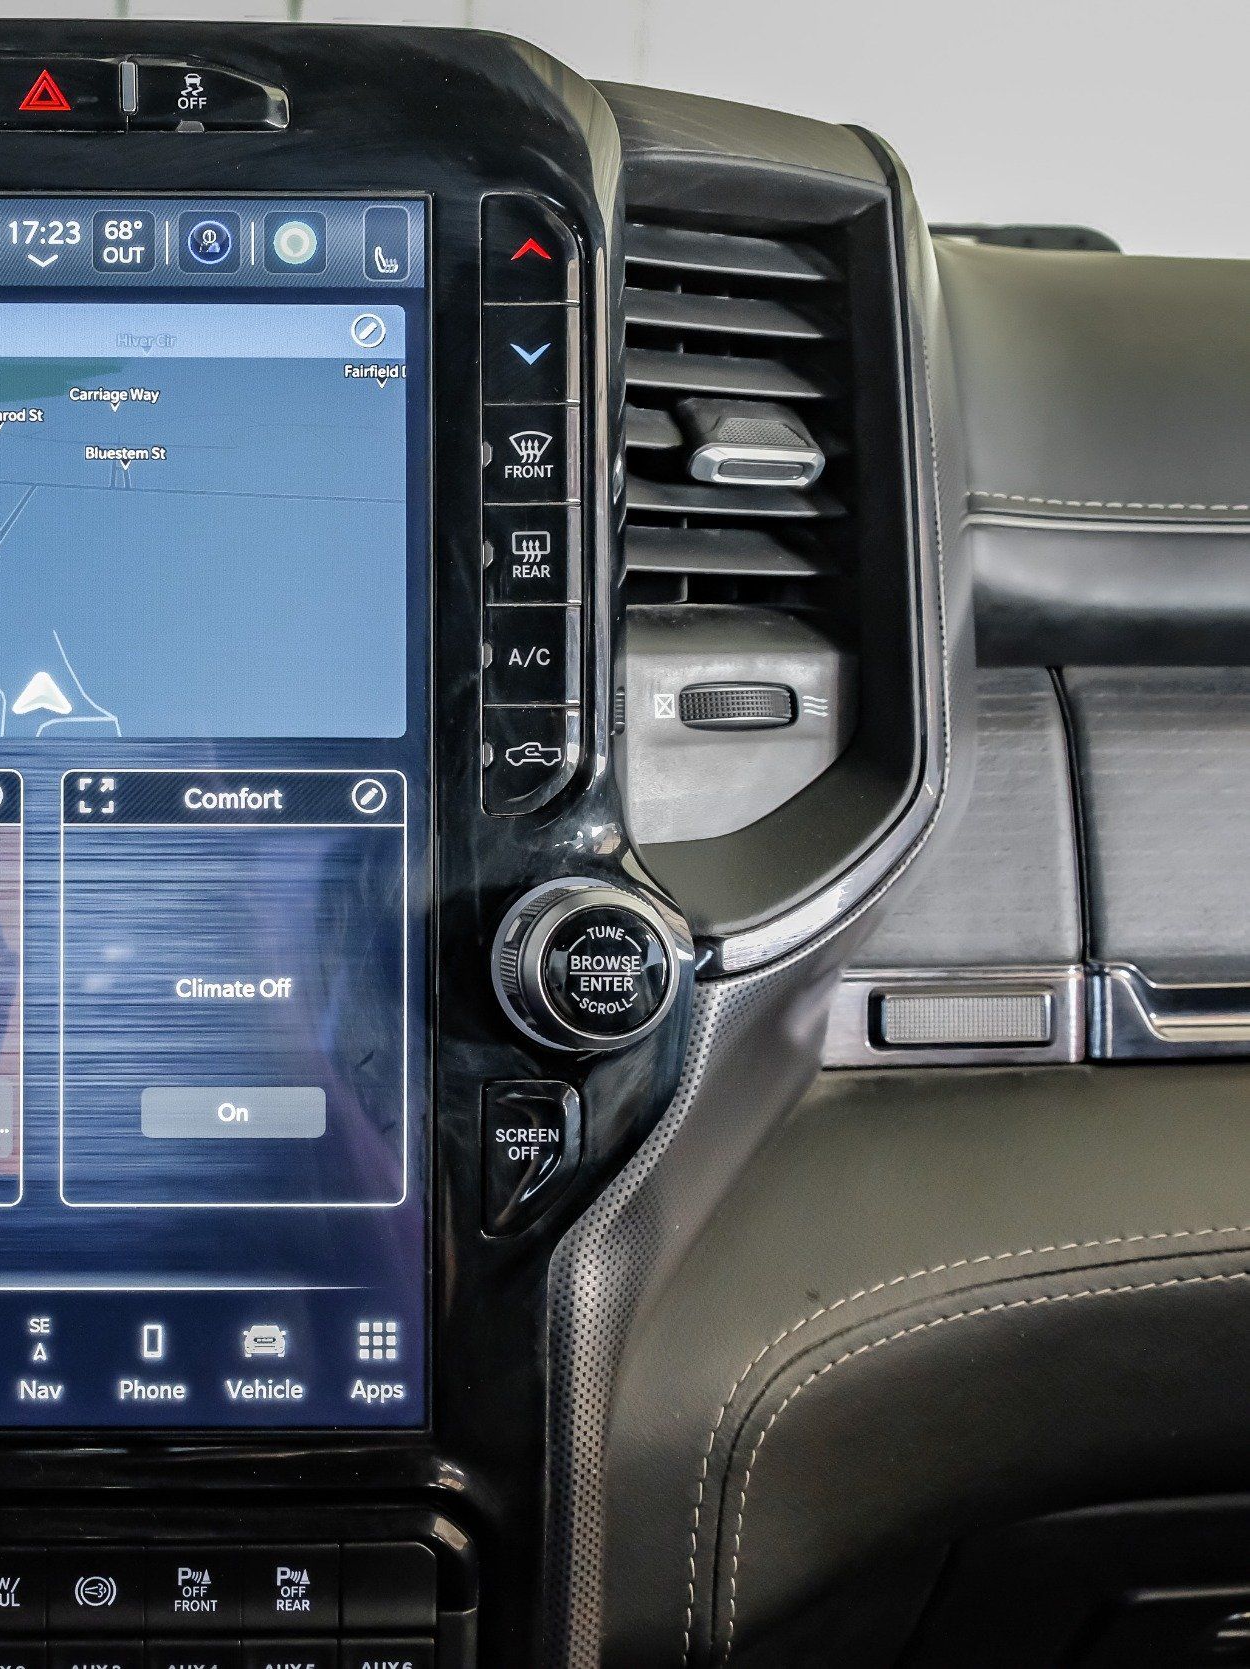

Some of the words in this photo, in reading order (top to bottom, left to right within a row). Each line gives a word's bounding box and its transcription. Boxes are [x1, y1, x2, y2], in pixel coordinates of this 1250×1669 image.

[177, 97, 207, 110] OFF
[8, 220, 81, 245] 17:23
[104, 219, 143, 240] 68°
[102, 244, 146, 264] OUT
[344, 364, 399, 379] Fairfield
[69, 387, 128, 404] Carriage
[130, 388, 160, 404] Way
[28, 409, 44, 422] St
[85, 447, 149, 460] Bluestem
[151, 447, 167, 460] St
[504, 464, 554, 479] FRONT
[512, 564, 551, 578] REAR
[508, 646, 551, 668] A/C
[184, 788, 283, 811] Comfort
[587, 926, 625, 941] TUNE
[570, 955, 642, 972] BROWSE
[175, 975, 256, 998] Climate
[258, 977, 292, 999] Off
[579, 975, 635, 993] ENTER
[578, 996, 633, 1015] SCROLL
[217, 1102, 249, 1122] On
[495, 1128, 559, 1143] SCREEN
[507, 1147, 540, 1161] OFF
[29, 1317, 50, 1334] SE
[18, 1379, 63, 1400] Nav
[118, 1379, 187, 1401] Phone
[226, 1378, 304, 1400] Vehicle
[350, 1379, 405, 1404] Apps
[182, 1585, 208, 1598] OFF
[280, 1585, 306, 1598] OFF
[174, 1599, 218, 1612] FRONT
[276, 1599, 310, 1612] REAR
